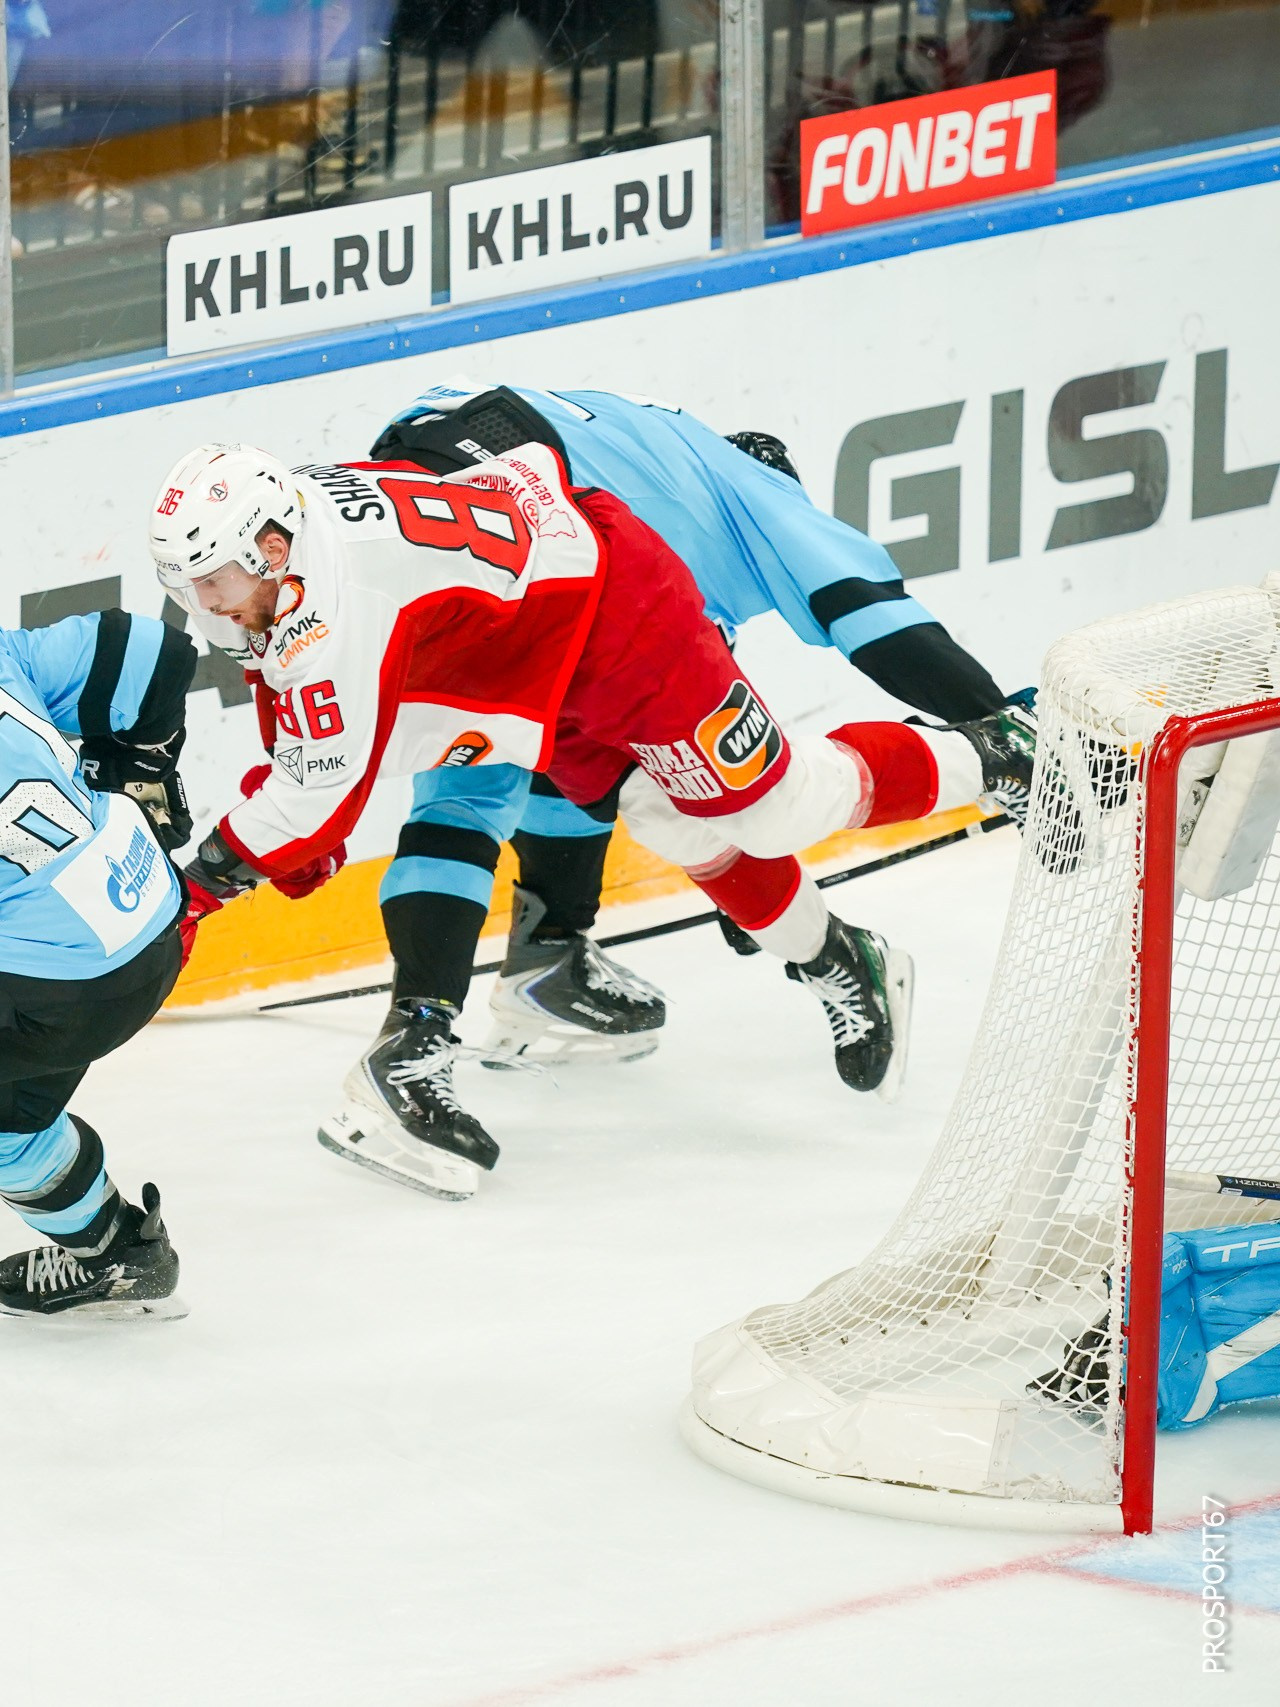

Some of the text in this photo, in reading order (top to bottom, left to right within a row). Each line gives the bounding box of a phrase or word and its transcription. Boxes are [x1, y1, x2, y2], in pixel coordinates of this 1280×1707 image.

[806, 94, 1053, 215] FONBET
[467, 168, 694, 271] KHL.RU
[184, 224, 416, 323] KHL.RU
[833, 349, 1280, 581] GISL
[157, 487, 184, 516] 86
[238, 507, 261, 538] CCM
[277, 623, 331, 669] UMMC
[273, 679, 345, 740] 86
[725, 702, 768, 758] WIN
[629, 739, 705, 773] SIMA
[176, 777, 187, 809] BAUER
[650, 766, 723, 800] LAND
